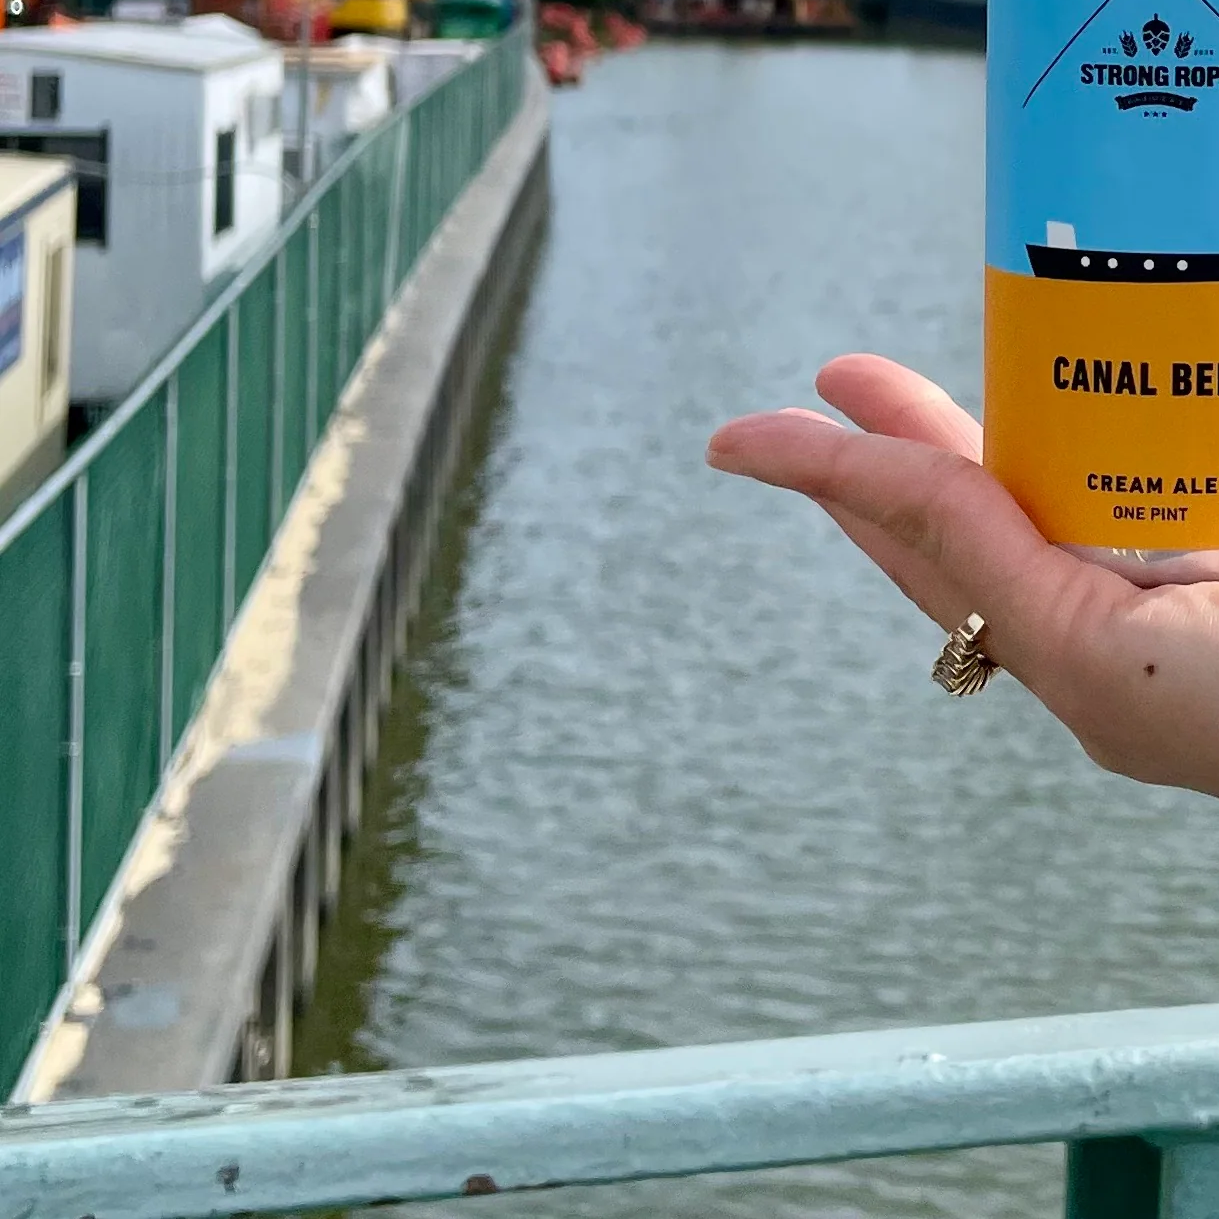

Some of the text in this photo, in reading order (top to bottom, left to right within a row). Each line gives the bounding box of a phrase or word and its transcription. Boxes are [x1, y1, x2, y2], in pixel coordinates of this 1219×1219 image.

[1080, 63, 1169, 87] STRONG
[1053, 355, 1158, 396] CANAL
[1087, 473, 1218, 495] CREAM ALE
[1113, 505, 1189, 522] ONE PINT
